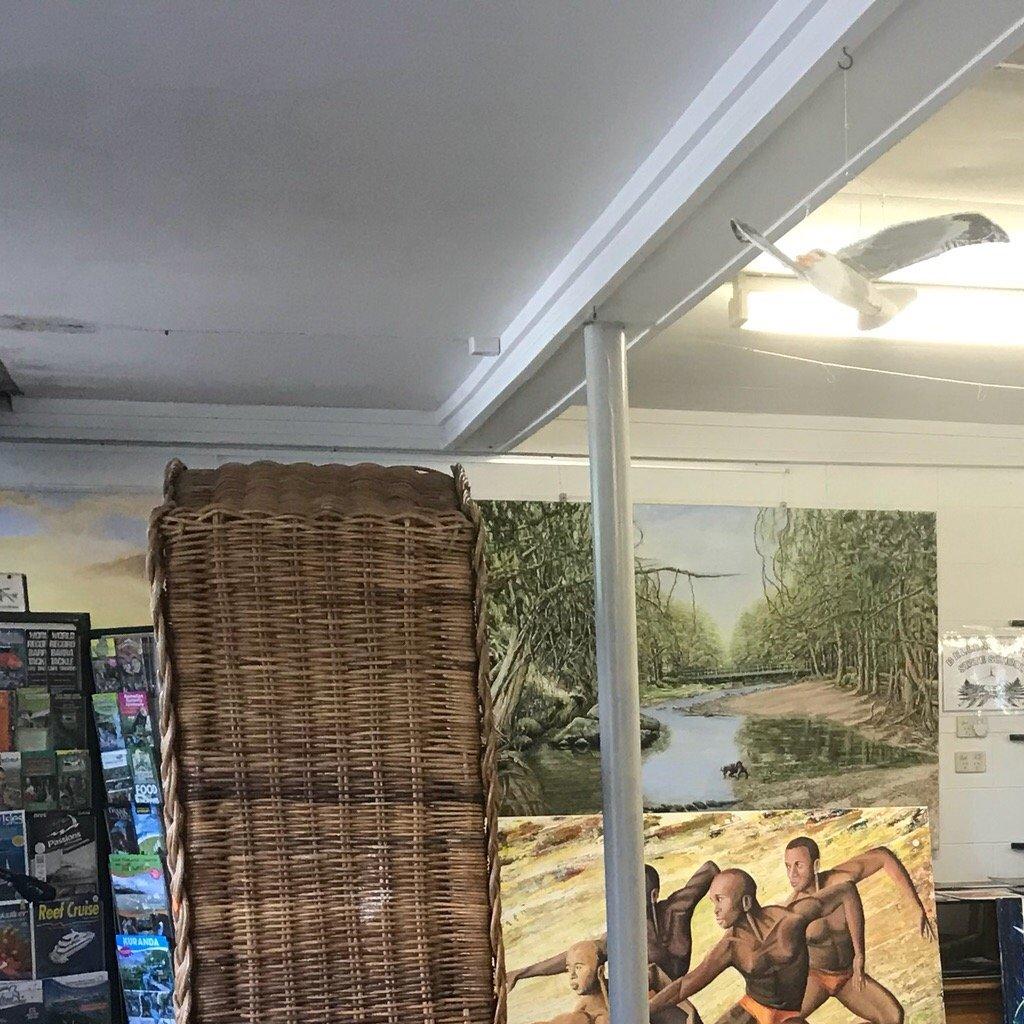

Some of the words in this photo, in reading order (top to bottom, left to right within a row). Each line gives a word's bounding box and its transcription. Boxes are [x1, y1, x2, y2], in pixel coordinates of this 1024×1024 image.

[38, 902, 64, 921] Reef
[67, 899, 100, 918] Cruise
[122, 936, 160, 947] KURANDA
